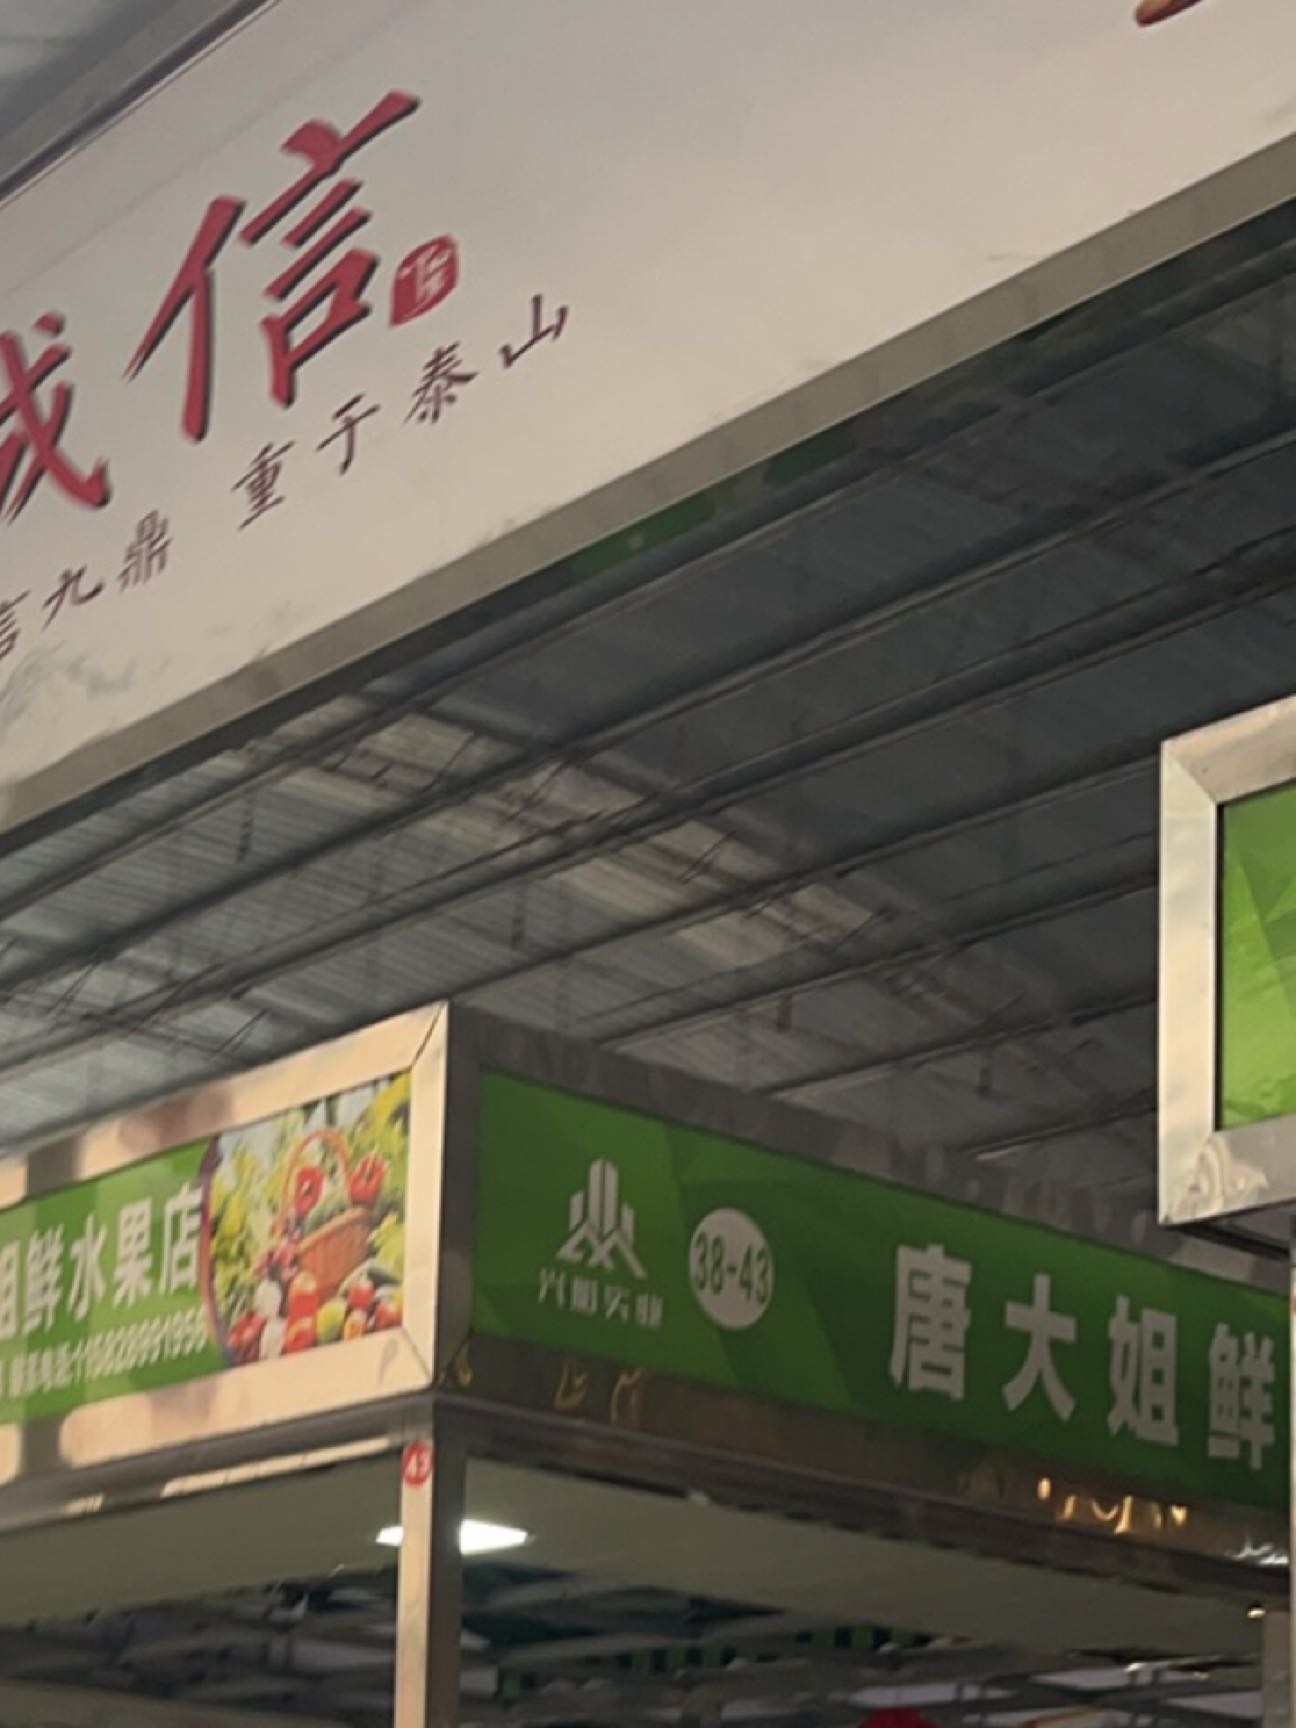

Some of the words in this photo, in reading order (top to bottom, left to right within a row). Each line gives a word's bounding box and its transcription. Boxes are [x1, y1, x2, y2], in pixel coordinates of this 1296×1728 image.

[230, 293, 570, 532] 重于泰山
[693, 1229, 771, 1307] 38-43
[887, 1242, 1277, 1472] 唐大姐鲜
